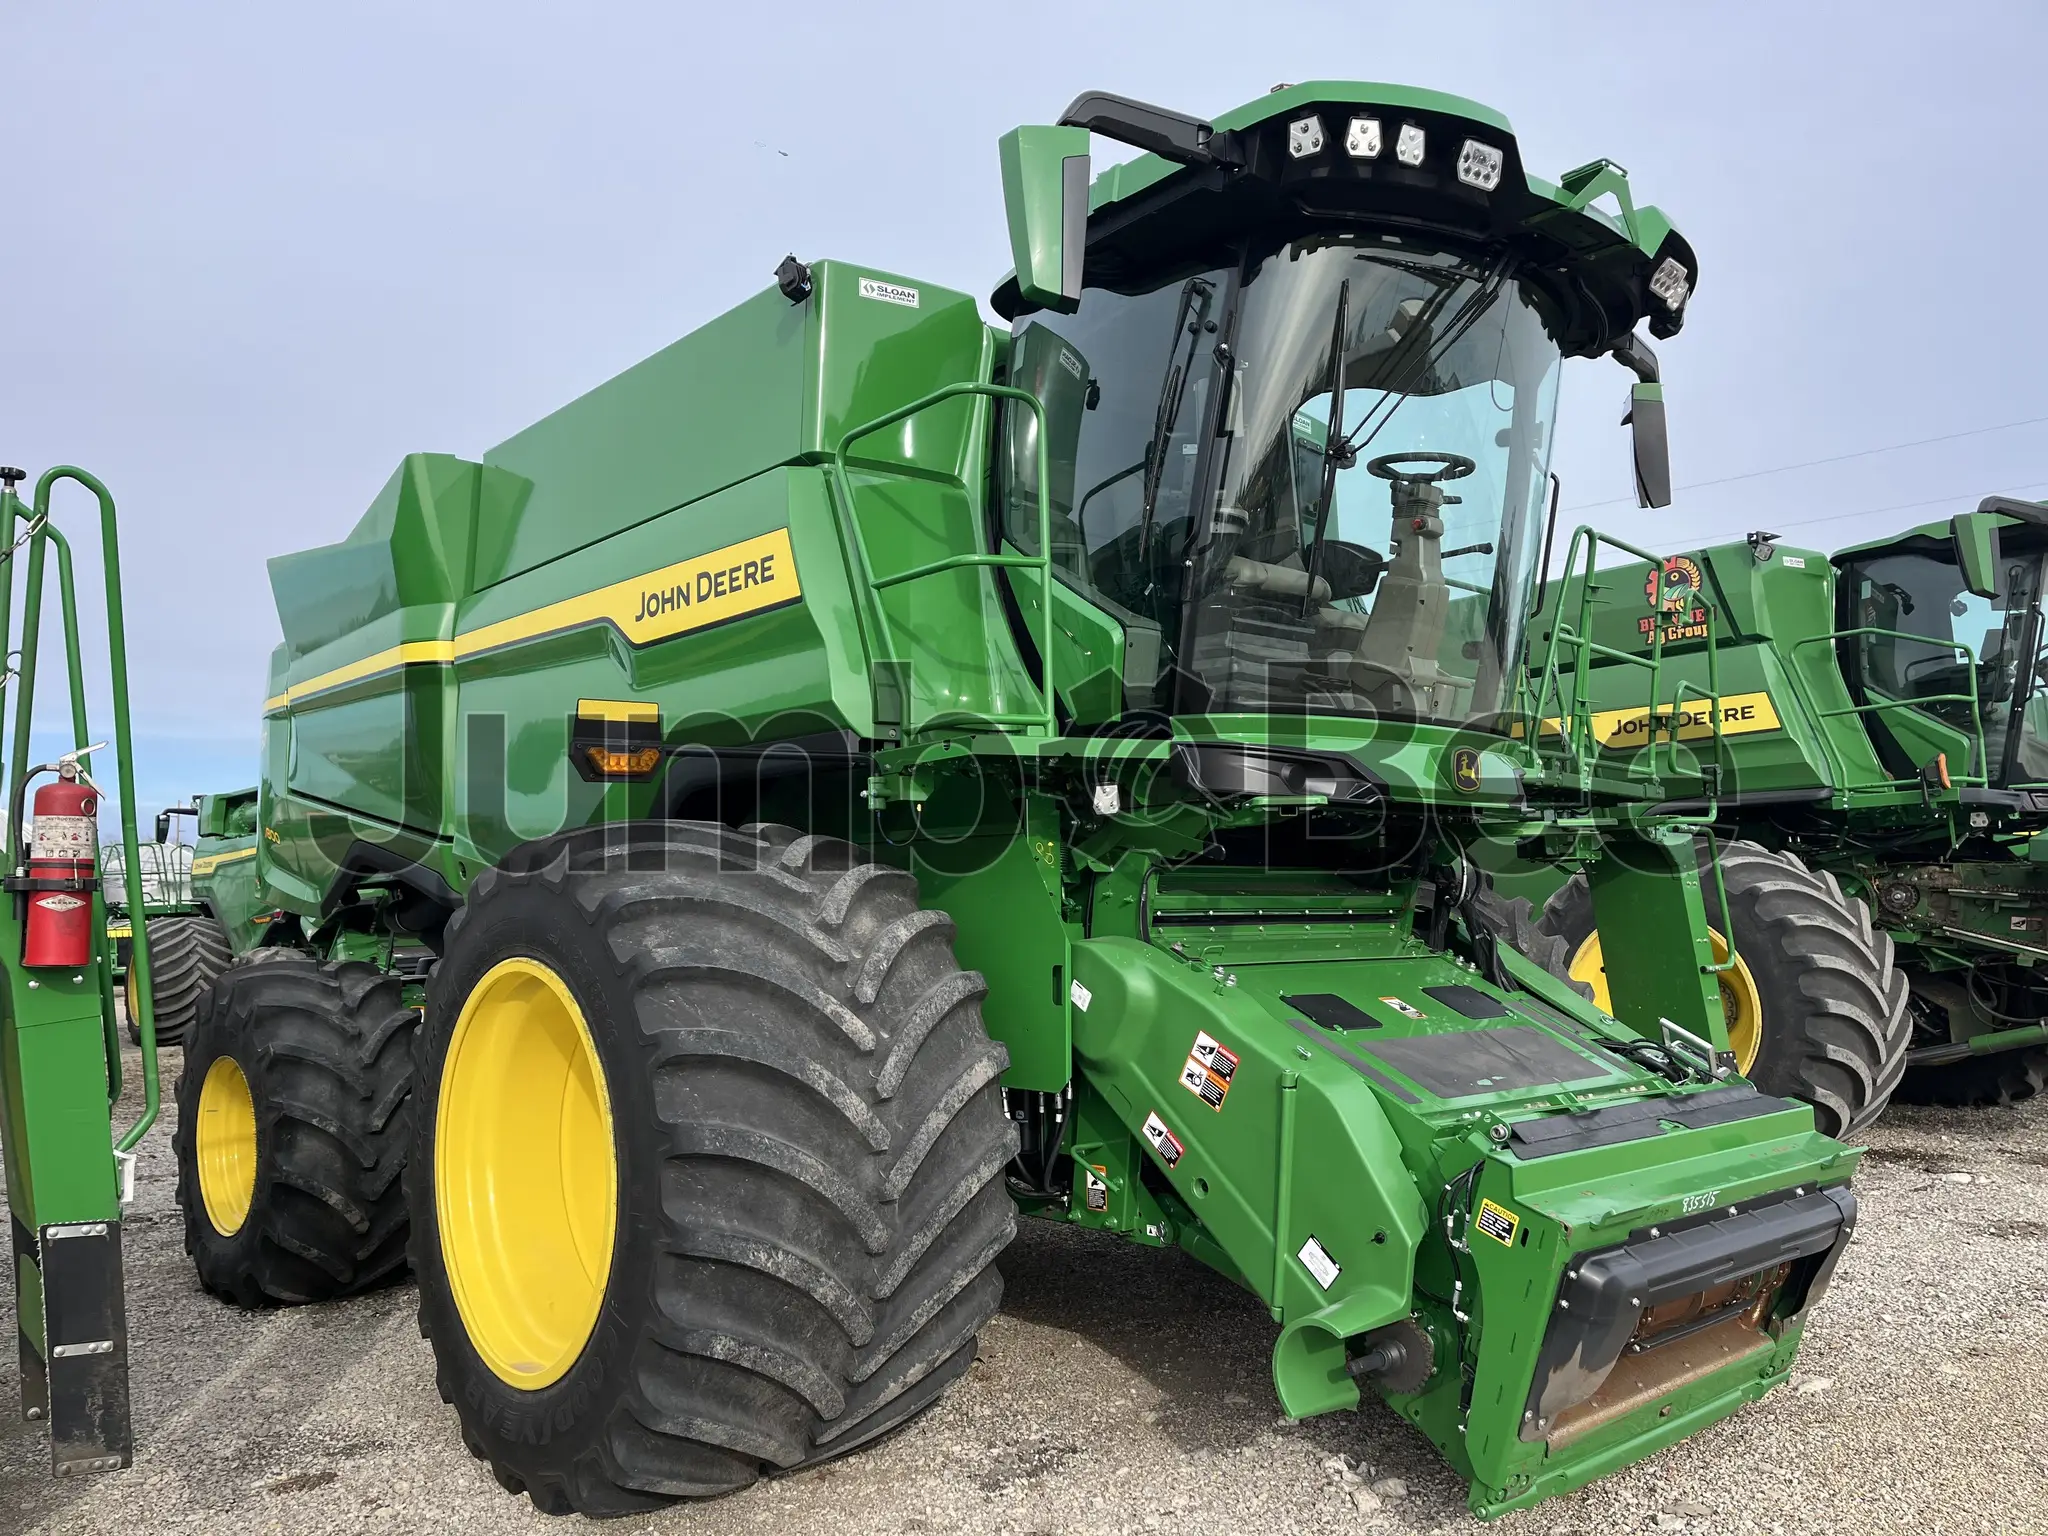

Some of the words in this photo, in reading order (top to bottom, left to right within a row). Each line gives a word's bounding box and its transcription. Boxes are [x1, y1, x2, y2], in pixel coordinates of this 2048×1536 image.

[876, 292, 915, 303] IMPLEMENT
[877, 285, 915, 299] SLOAN
[635, 582, 690, 622] JOHN
[697, 554, 775, 603] DEERE
[1489, 1203, 1517, 1222] CAUTION
